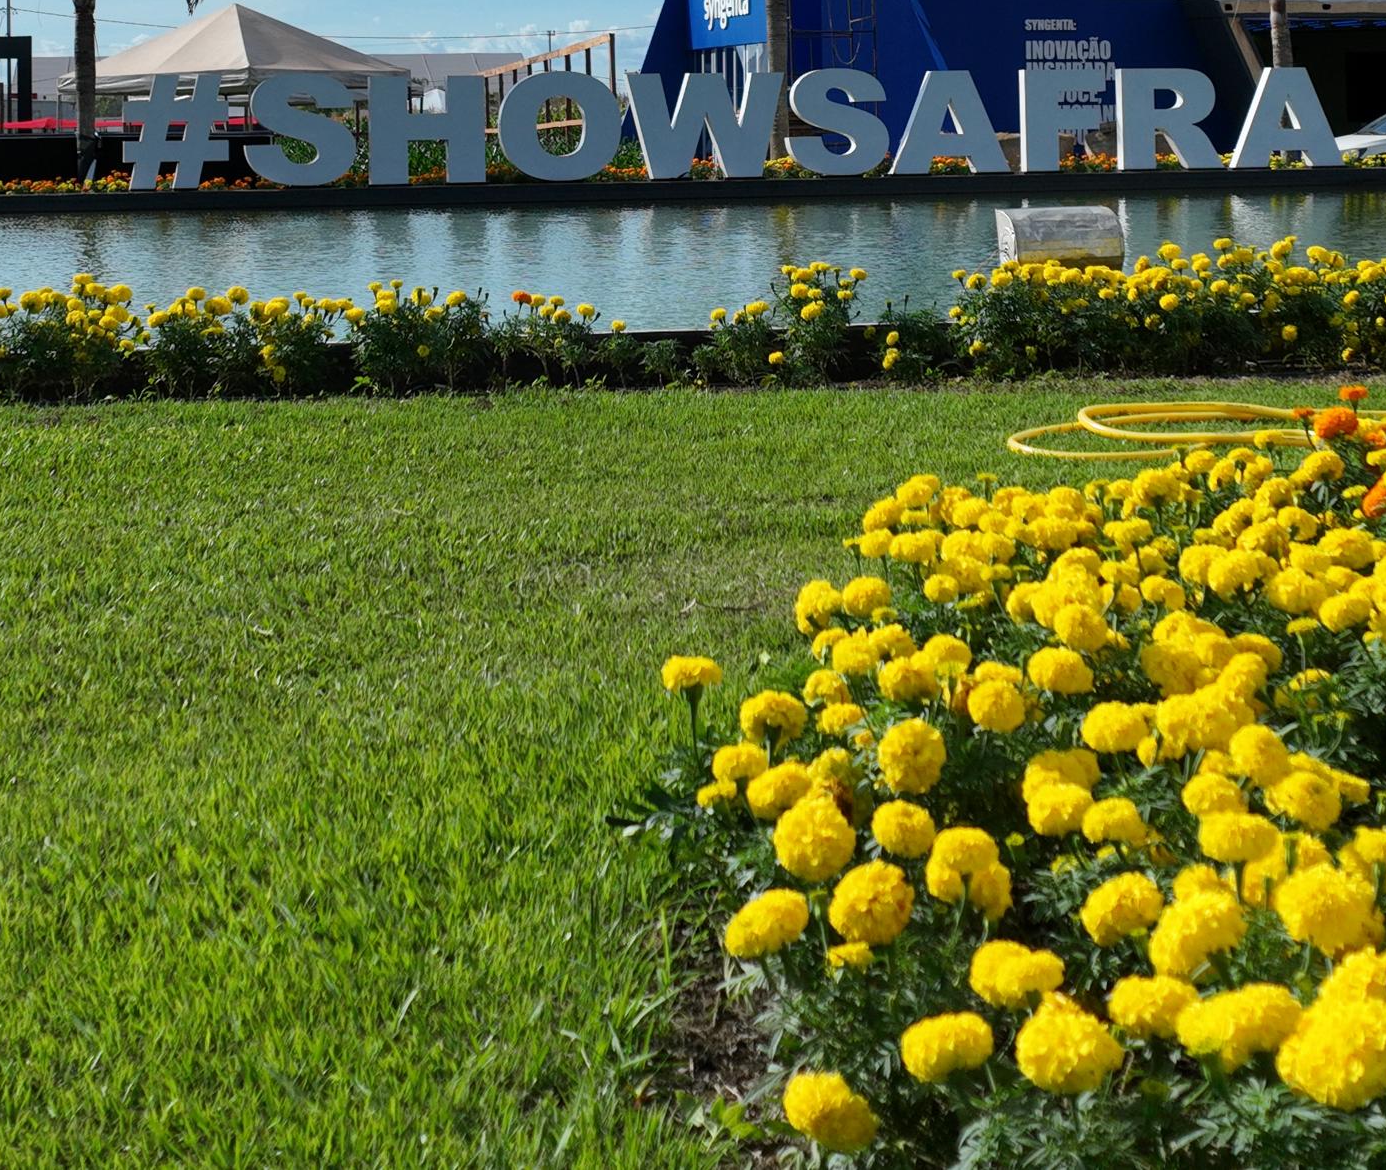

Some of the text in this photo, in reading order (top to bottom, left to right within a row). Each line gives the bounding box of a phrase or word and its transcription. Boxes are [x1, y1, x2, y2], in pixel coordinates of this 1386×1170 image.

[1024, 18, 1077, 31] SYNGENTA:
[1025, 36, 1112, 63] INOVAÇÃO
[122, 67, 1345, 191] #SHOWSAFRA
